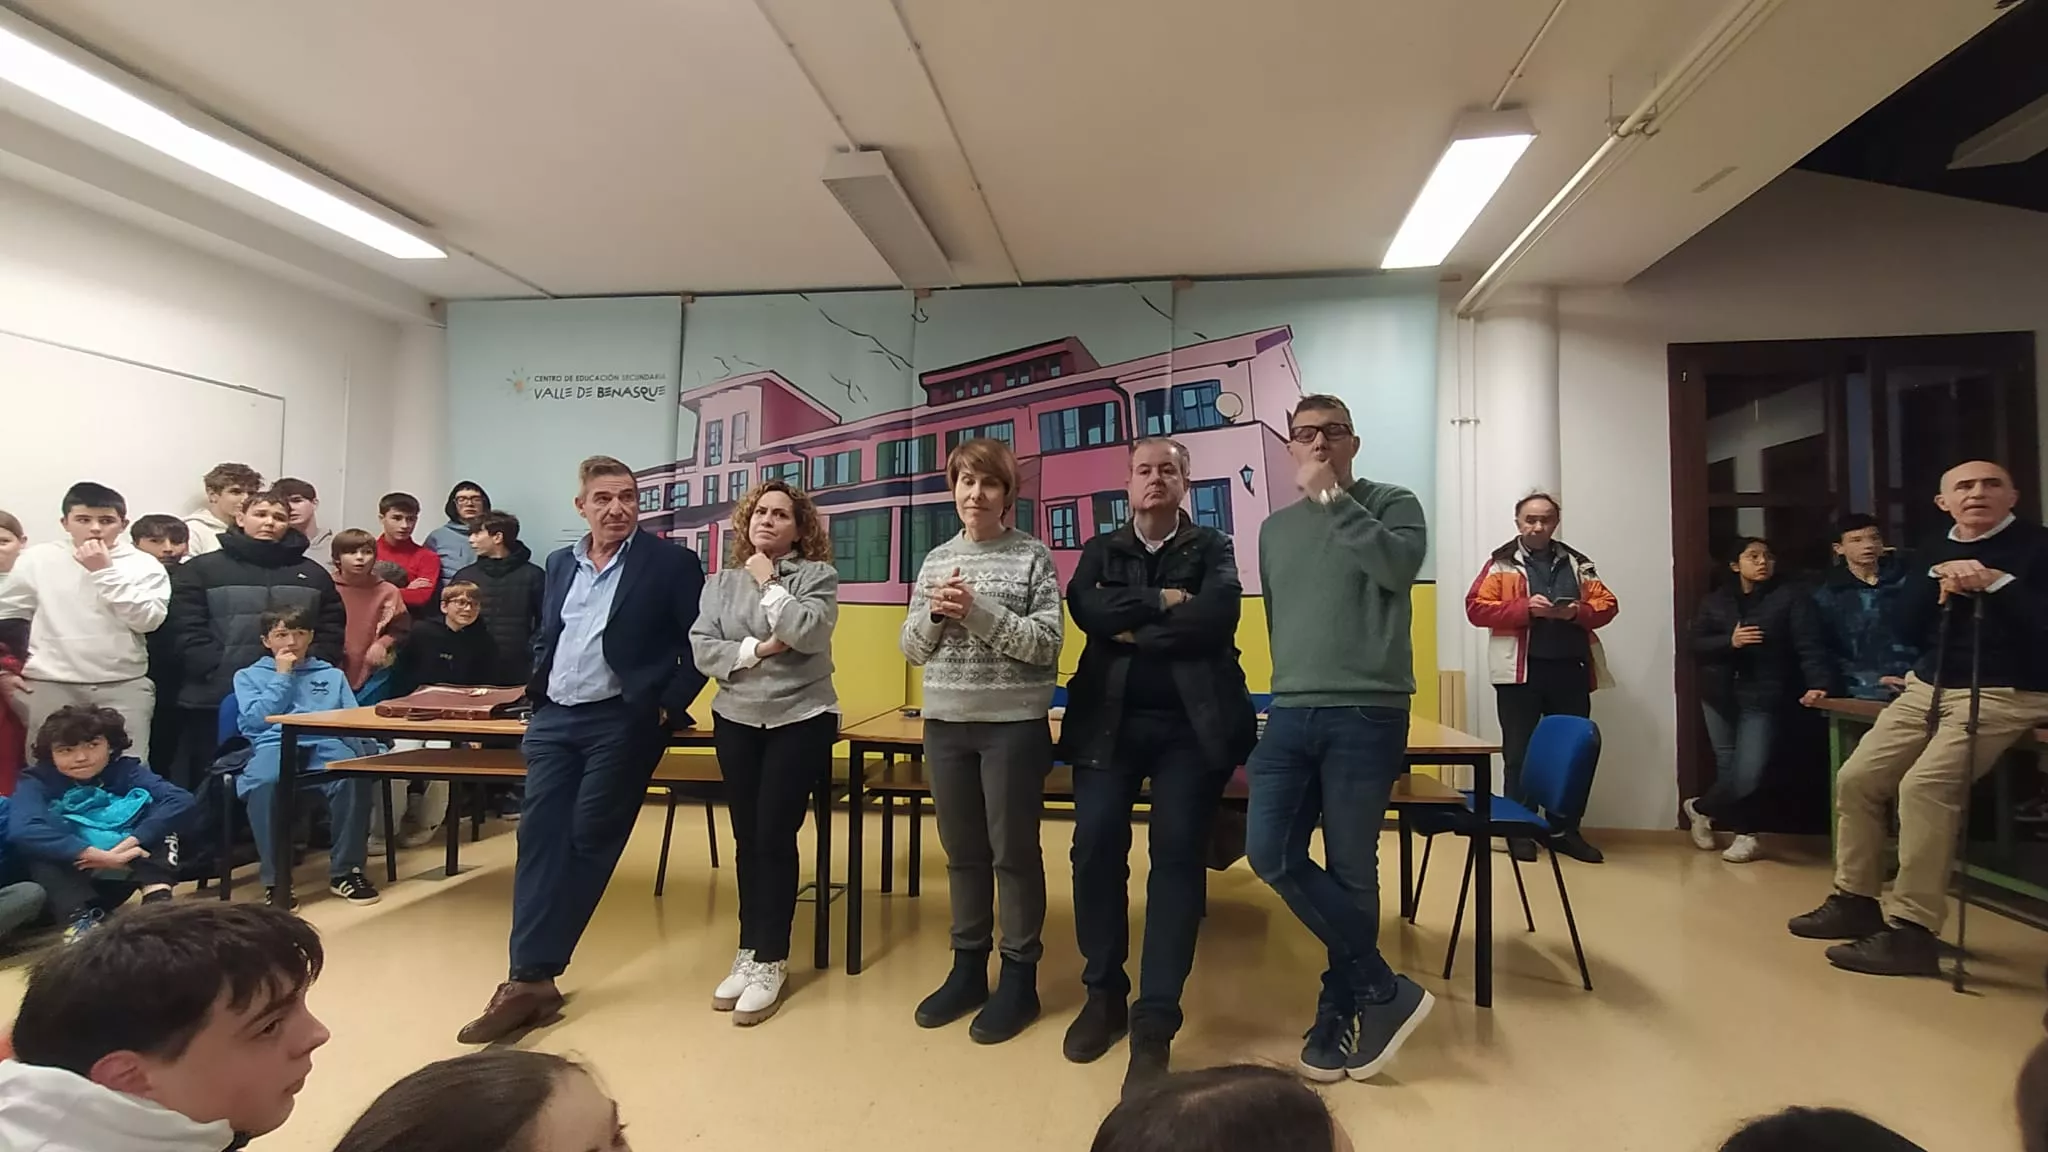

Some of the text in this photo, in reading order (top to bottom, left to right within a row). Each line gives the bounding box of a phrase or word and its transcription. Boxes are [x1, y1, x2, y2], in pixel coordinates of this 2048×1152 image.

[576, 373, 619, 382] EDUCACIÓN
[621, 373, 666, 381] SECUNDARIA
[534, 385, 666, 402] VALLE DE BENASQUE
